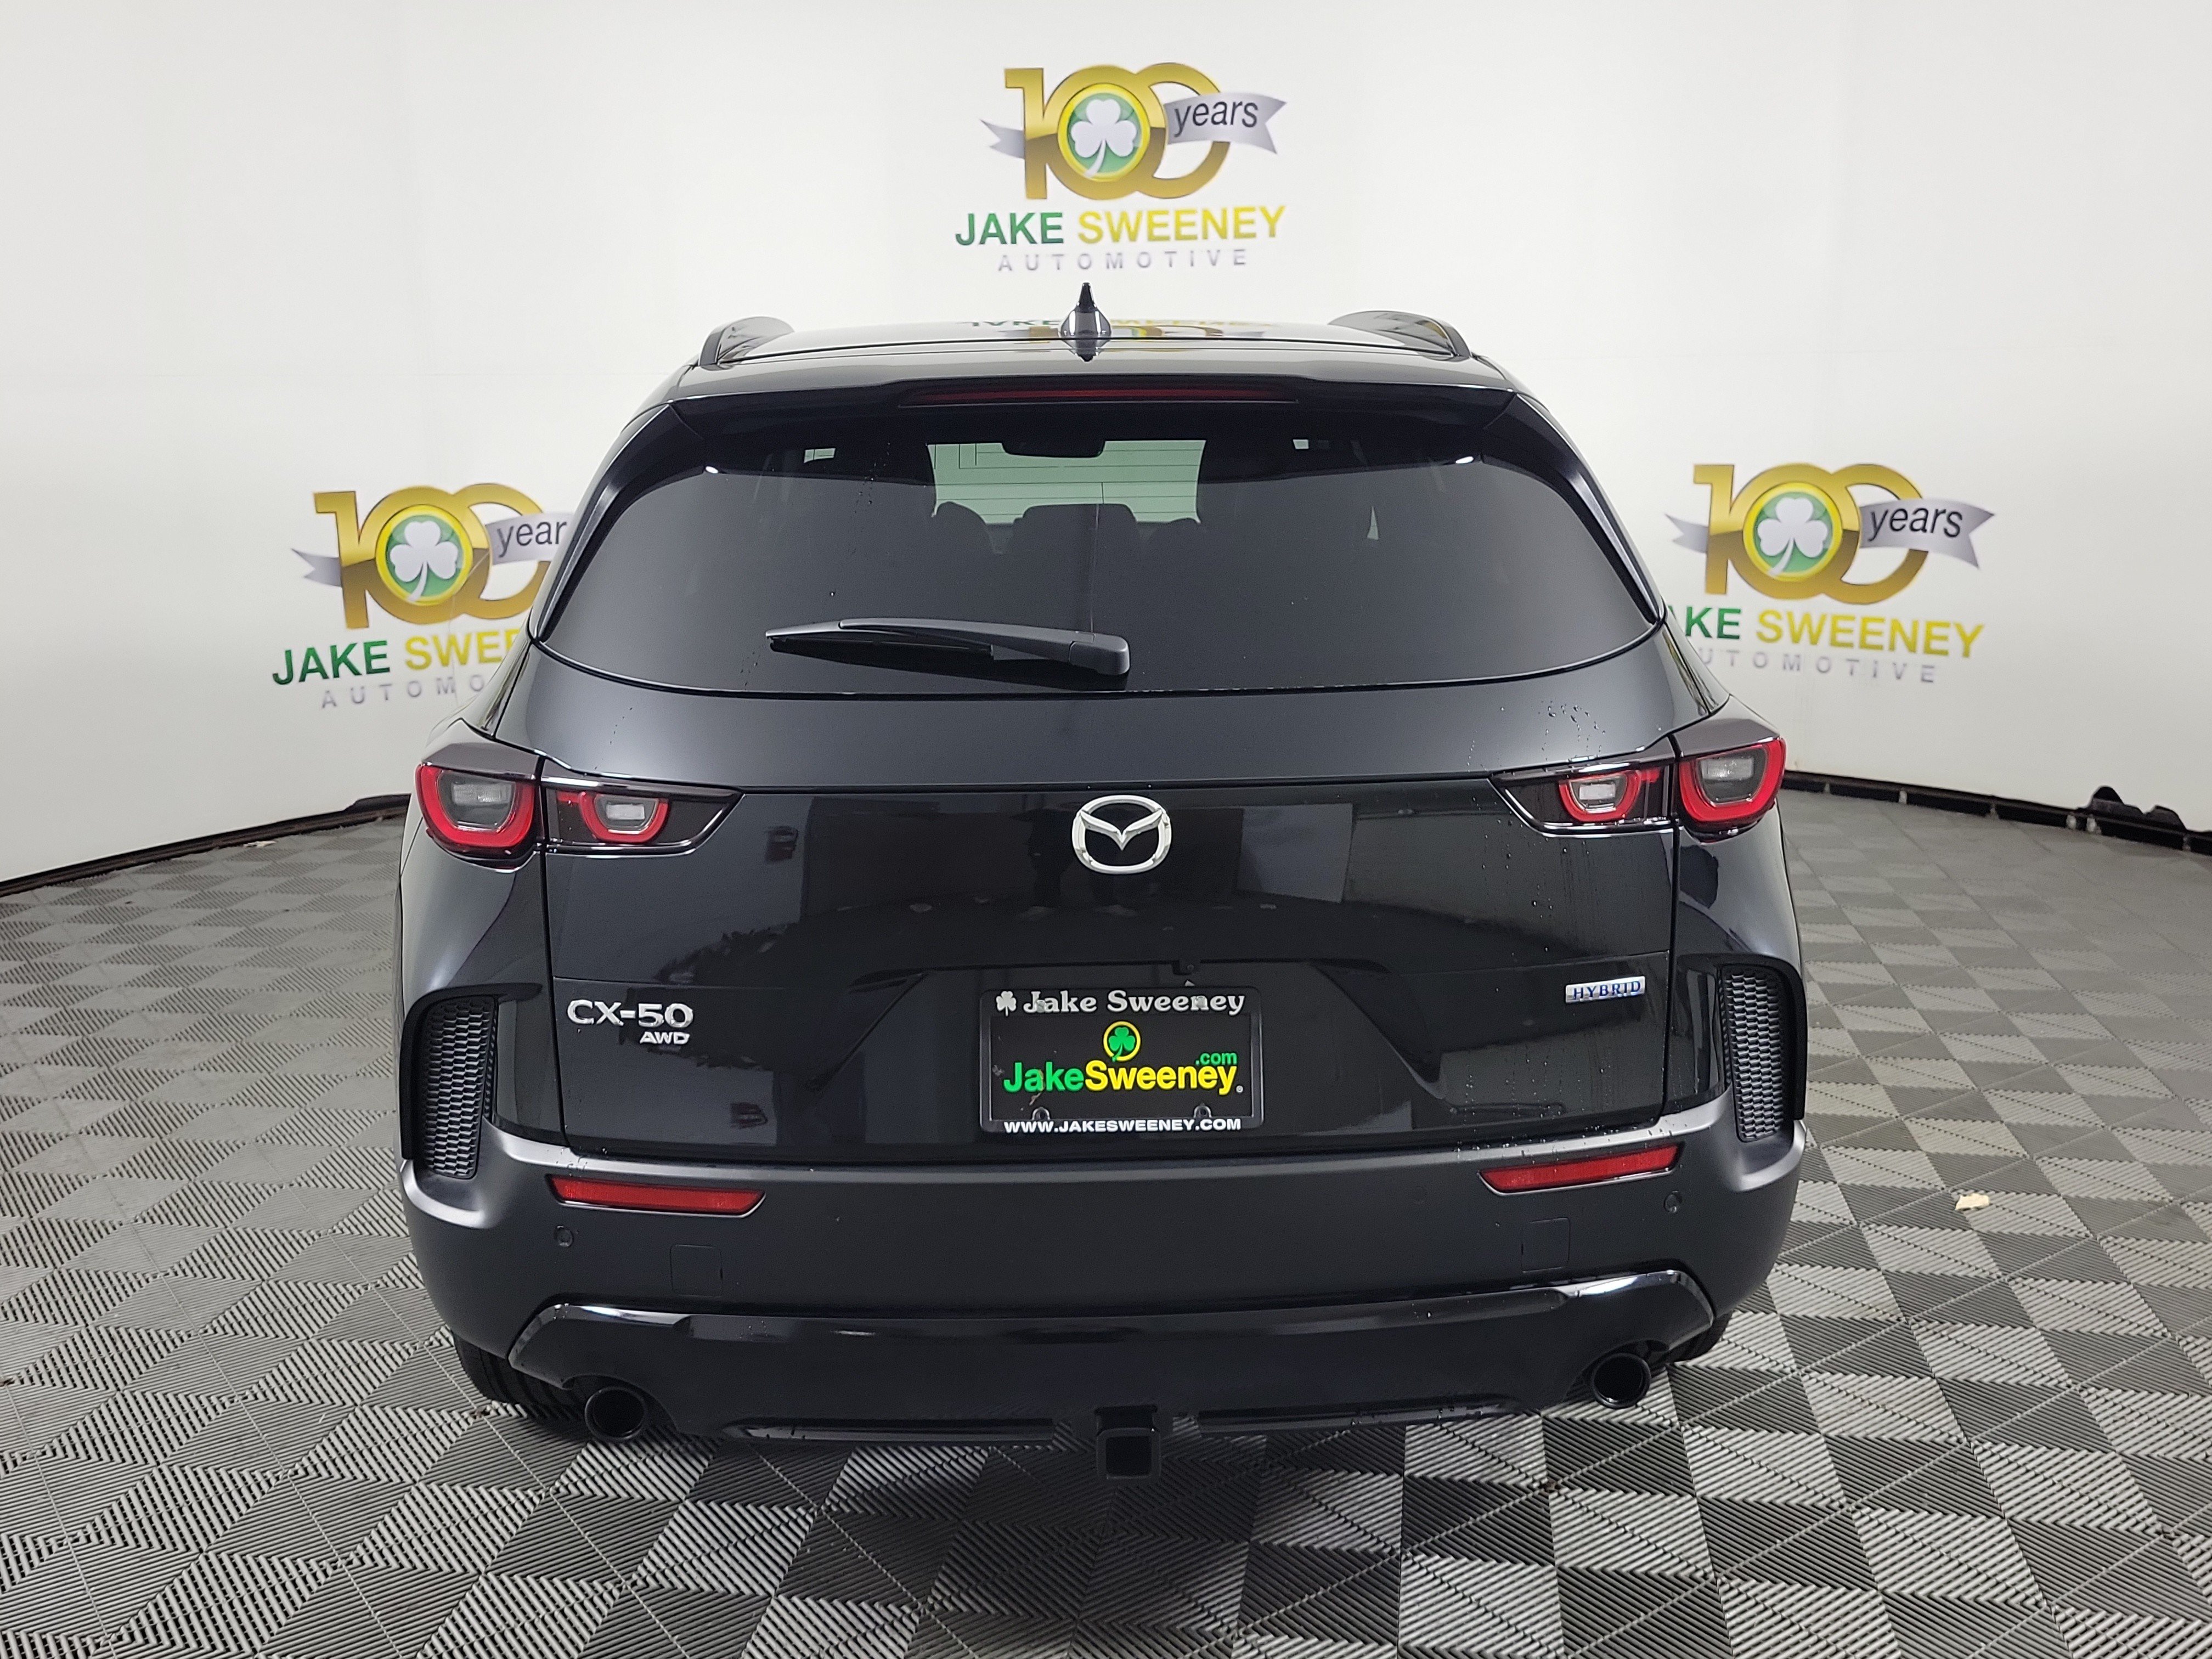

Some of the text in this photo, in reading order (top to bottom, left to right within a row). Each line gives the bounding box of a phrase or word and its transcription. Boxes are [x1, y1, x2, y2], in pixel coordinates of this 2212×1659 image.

[1005, 63, 1258, 200] 100 years
[955, 206, 1285, 246] JAKE SWEENEY
[998, 250, 1246, 272] AUTOMOTIVE
[1694, 463, 1963, 604] 100 years
[313, 483, 551, 629] 100
[1668, 606, 1985, 658] KE SWEENEY
[273, 640, 391, 685] JAKE
[1023, 990, 1245, 1015] Jake Sweeney
[1573, 980, 1641, 1000] HYBRID
[567, 999, 693, 1028] CX-50
[640, 1031, 690, 1045] AWD
[1195, 1053, 1237, 1065] .com
[1005, 1118, 1241, 1133] WWW.JAKESWEENEY.COM
